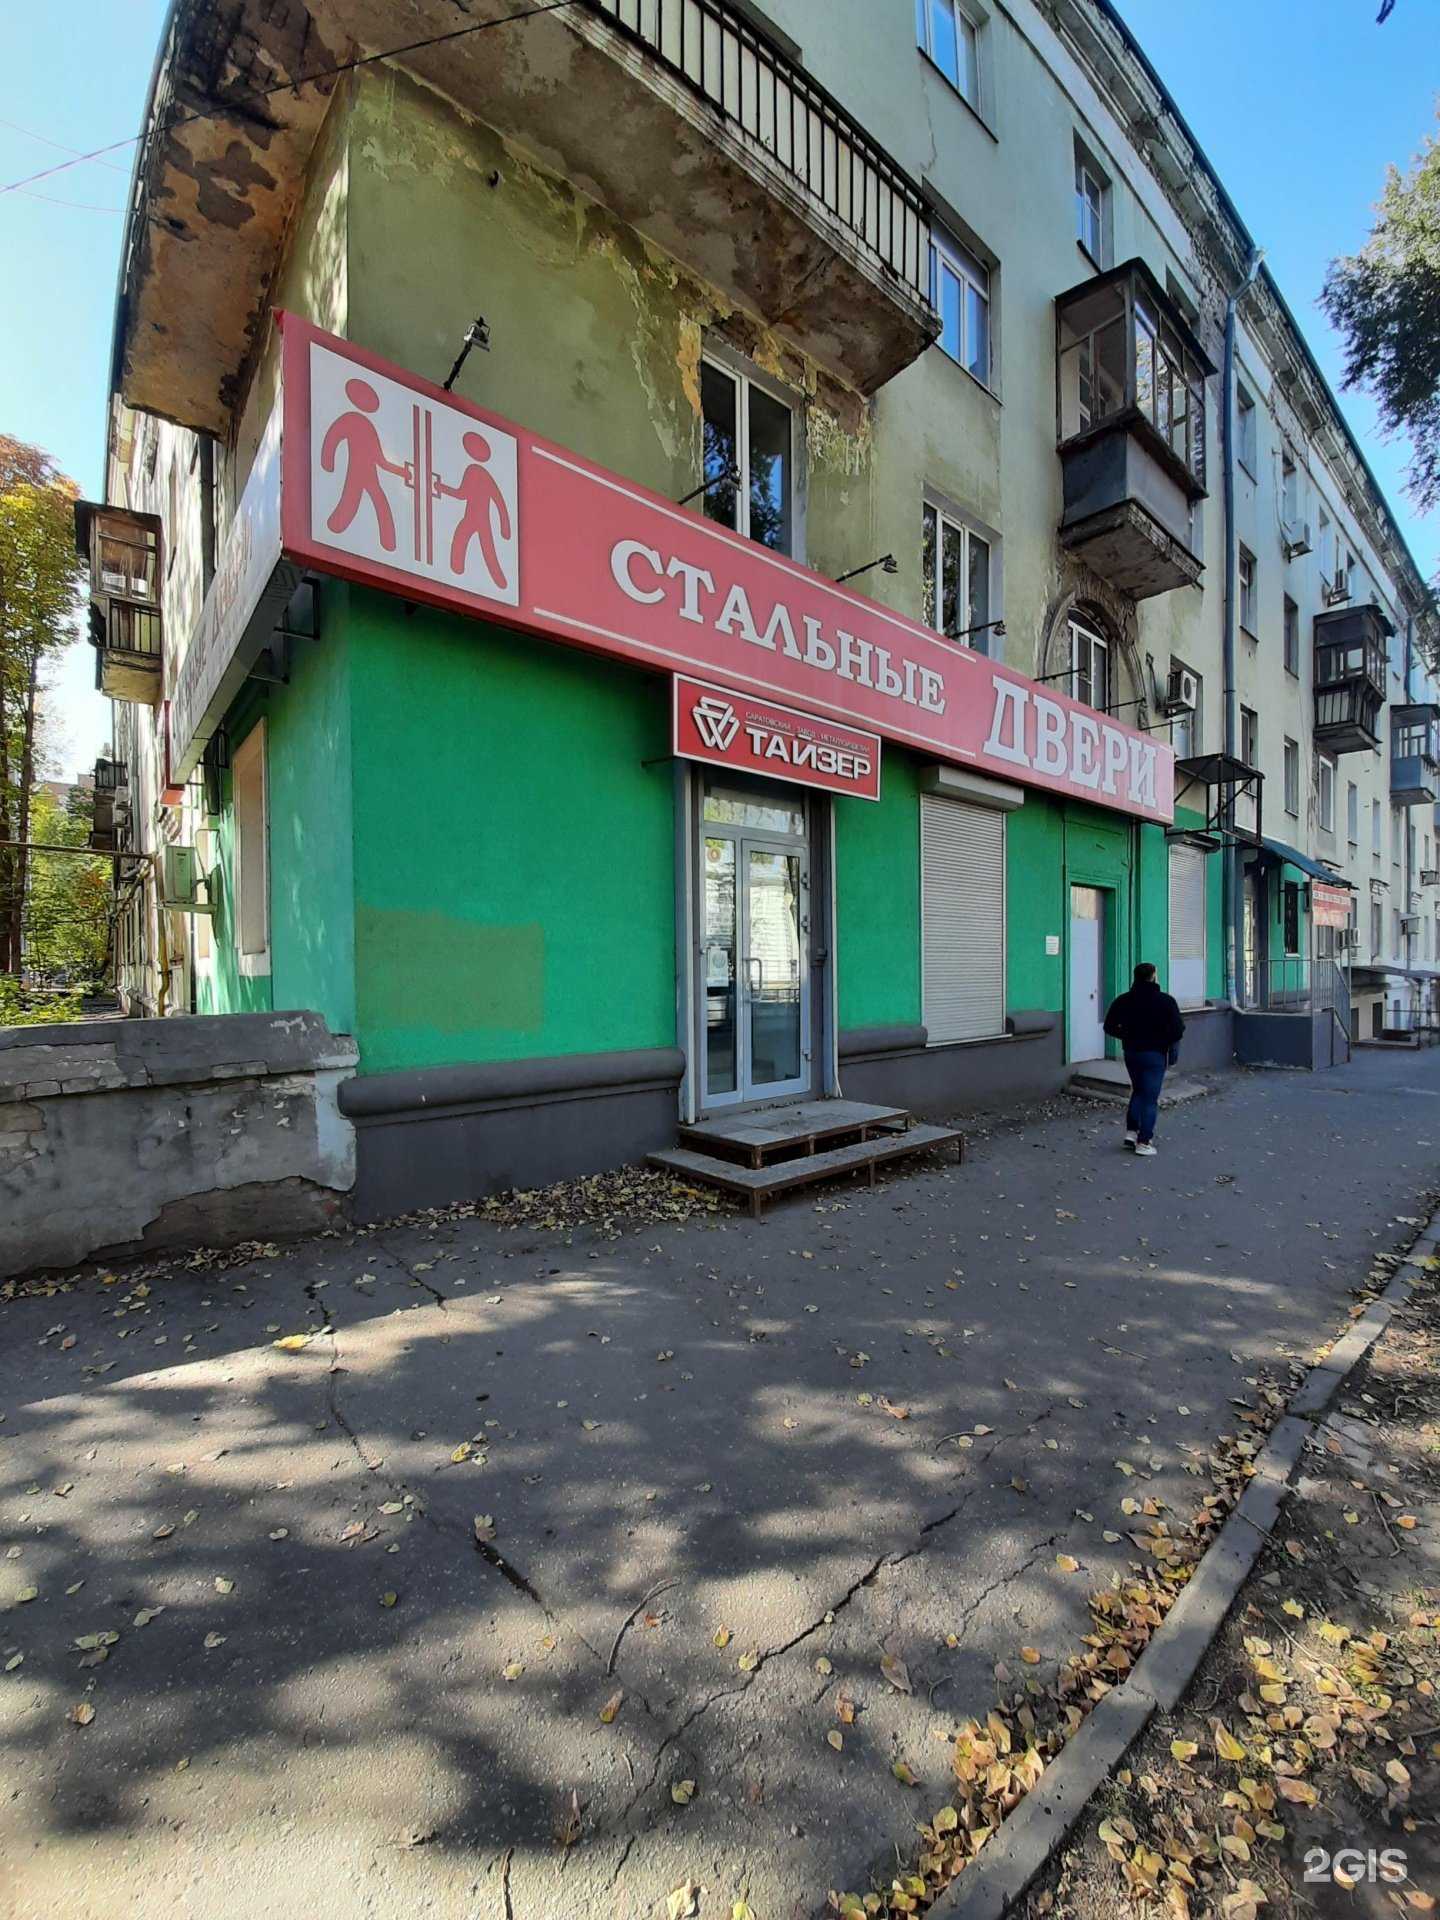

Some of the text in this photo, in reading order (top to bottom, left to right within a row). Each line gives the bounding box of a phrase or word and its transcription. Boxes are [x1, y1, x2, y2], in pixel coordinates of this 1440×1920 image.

[610, 539, 1157, 809] СТАЛЬНЫЕ ДВЕРИ
[745, 726, 871, 780] ТАЙЗЕР
